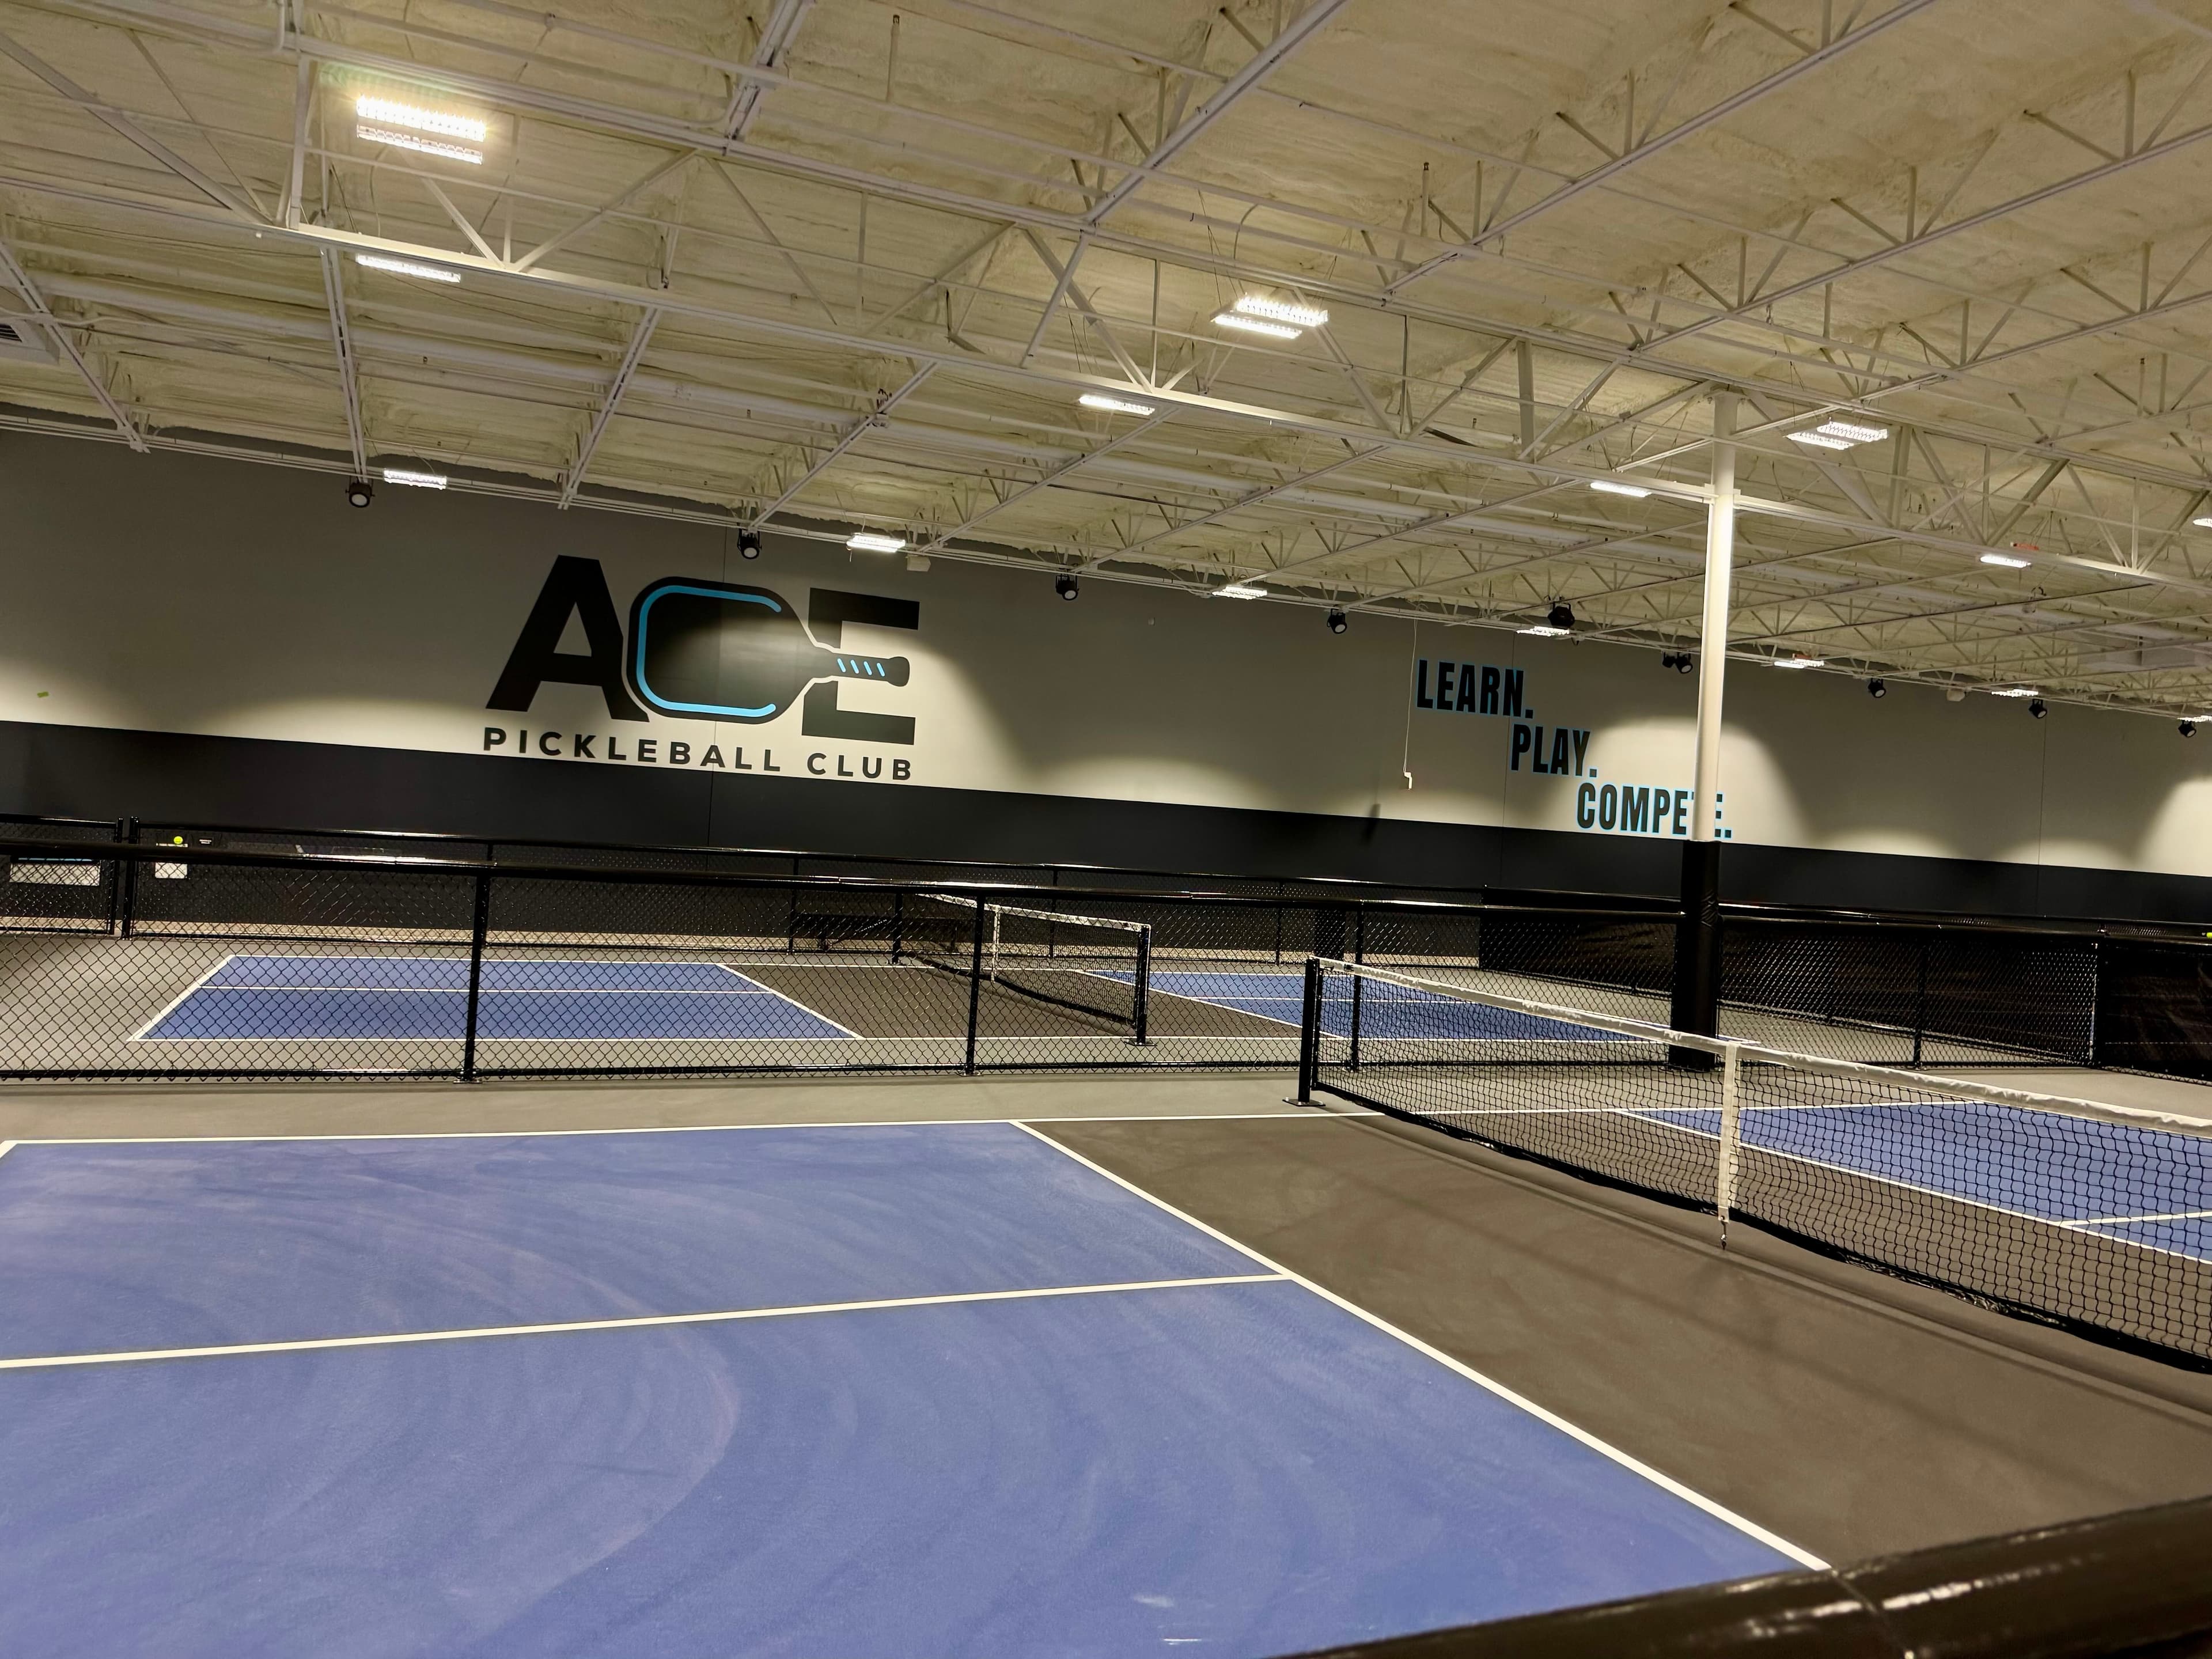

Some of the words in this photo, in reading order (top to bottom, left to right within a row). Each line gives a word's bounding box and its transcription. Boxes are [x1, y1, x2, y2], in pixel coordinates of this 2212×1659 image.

[485, 554, 921, 745] ACE
[1415, 658, 1535, 719] LEARN.
[483, 726, 781, 772] PICKLEBALL
[806, 752, 911, 781] CLUB
[1510, 723, 1598, 778] PLAY.
[1576, 782, 1733, 839] COMPE.
